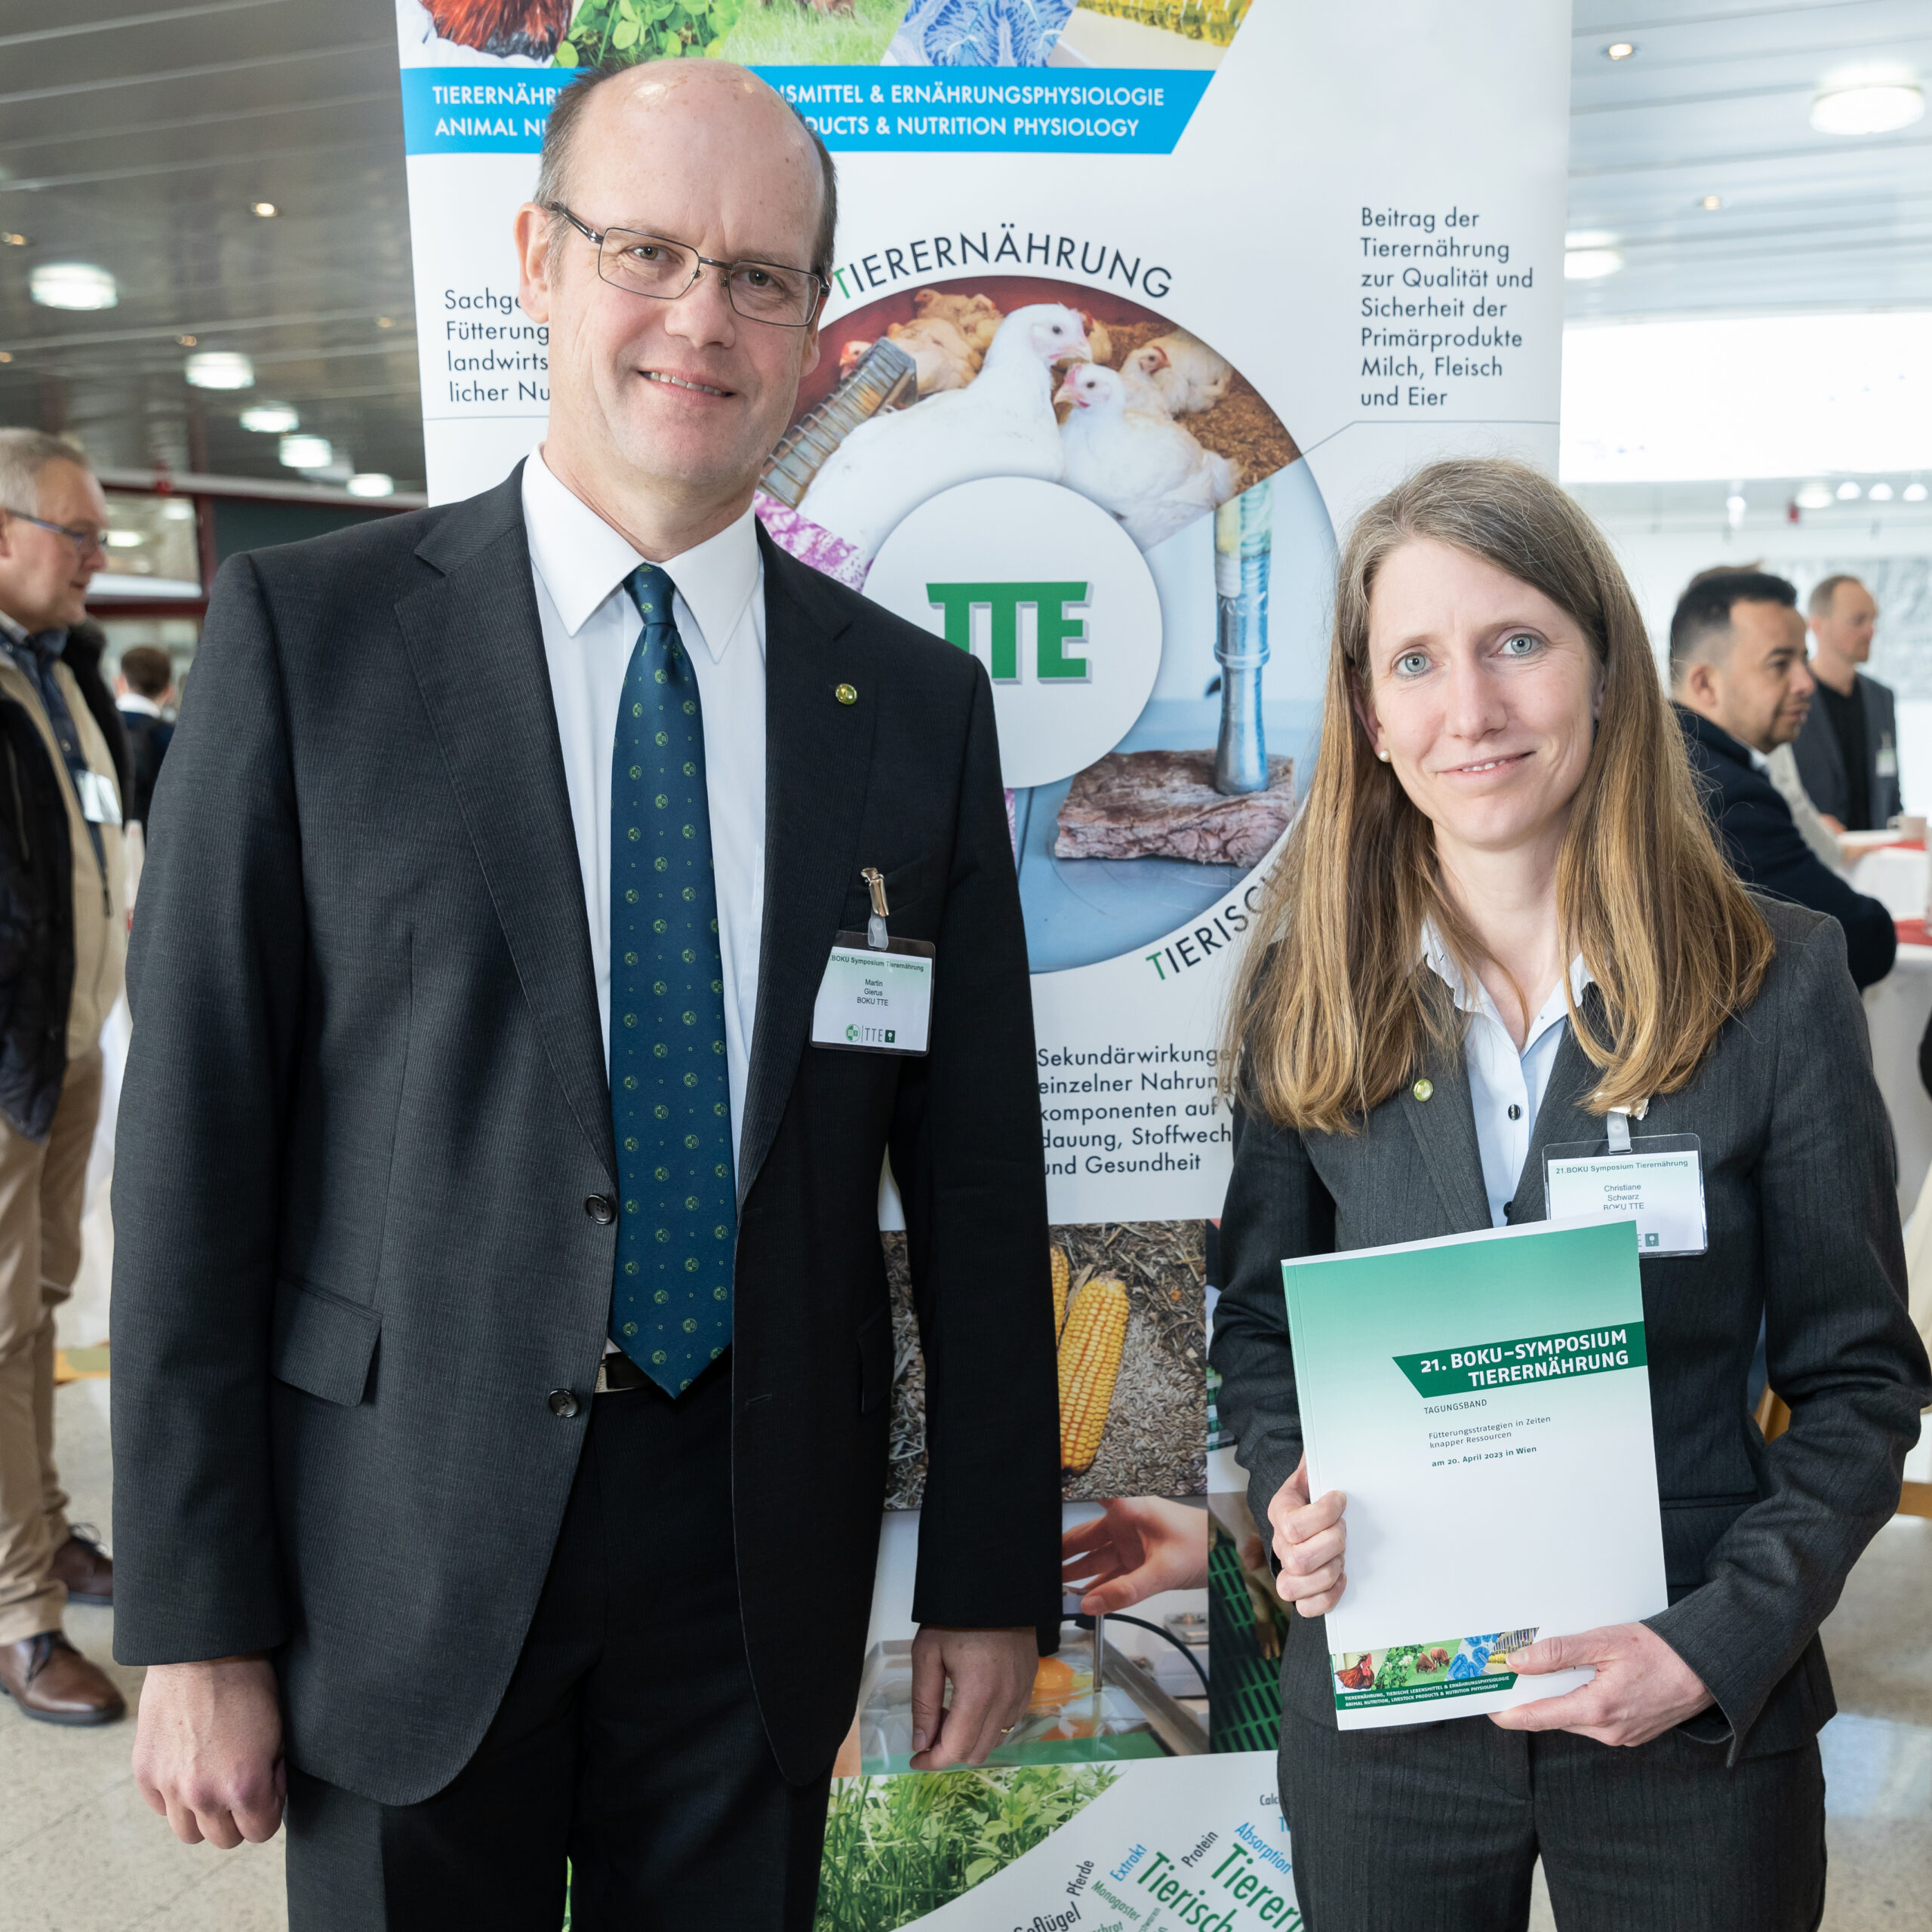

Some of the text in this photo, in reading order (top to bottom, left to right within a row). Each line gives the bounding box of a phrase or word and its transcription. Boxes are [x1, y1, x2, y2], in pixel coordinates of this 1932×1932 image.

[780, 82, 1164, 107] SMITTEL & ERNÄHRUNGSPHYSIOLOGIE
[435, 118, 518, 137] ANIMAL
[875, 116, 891, 135] &
[897, 115, 1007, 136] NUTRITION
[1014, 117, 1140, 137] PHYSIOLOGY
[1361, 205, 1479, 233] Beitrag der
[833, 223, 1172, 299] TIERERNÄHRUNG
[1361, 236, 1509, 264] Tierernährung
[1361, 266, 1533, 288] zur Qualität und
[1361, 296, 1507, 317] Sicherheit der
[1361, 325, 1522, 352] Primärprodukte
[1361, 355, 1503, 380] Milch, Fleisch
[450, 380, 509, 401] licher
[1361, 385, 1447, 406] und Eier
[925, 581, 1094, 685] TTE
[851, 957, 884, 967] Symposium
[886, 961, 924, 972] Tierernährung
[864, 988, 883, 996] Gierus
[865, 979, 883, 987] Martin
[857, 996, 875, 1005] BOKU
[1038, 1072, 1133, 1094] einzelner
[1186, 1096, 1217, 1116] auf
[1132, 1123, 1232, 1146] Stoffwech
[1085, 1152, 1201, 1174] Gesundheit
[1590, 1164, 1634, 1174] Symposium
[1636, 1160, 1688, 1169] Tierernährung
[1604, 1183, 1641, 1192] Christiane
[1607, 1193, 1640, 1201] Schwarz
[1420, 1328, 1627, 1374] 21. BOKU-SYMPOSIUM
[1467, 1349, 1629, 1387] TIERERNÄHRUNG
[1423, 1398, 1487, 1415] TAGUNGSBAND
[1428, 1422, 1513, 1440] Fütterungsstrategien
[1526, 1416, 1551, 1426] Zeiten
[1429, 1431, 1512, 1449] knapper Ressourcen
[1463, 1454, 1482, 1464] April
[1484, 1451, 1503, 1460] 2023
[1516, 1445, 1537, 1455] Wien
[1386, 1688, 1409, 1697] TIERISCHE
[1410, 1684, 1443, 1694] LEBENSMITTEL
[1391, 1694, 1414, 1703] LIVESTOCK
[1415, 1690, 1439, 1700] PRODUCTS
[1445, 1687, 1469, 1696] NUTRITION
[1181, 1830, 1218, 1868] Protein
[1235, 1822, 1292, 1875] Absorption
[1109, 1843, 1147, 1882] Extrakt
[1066, 1860, 1094, 1897] Pferde
[1091, 1880, 1141, 1921] Monogaster
